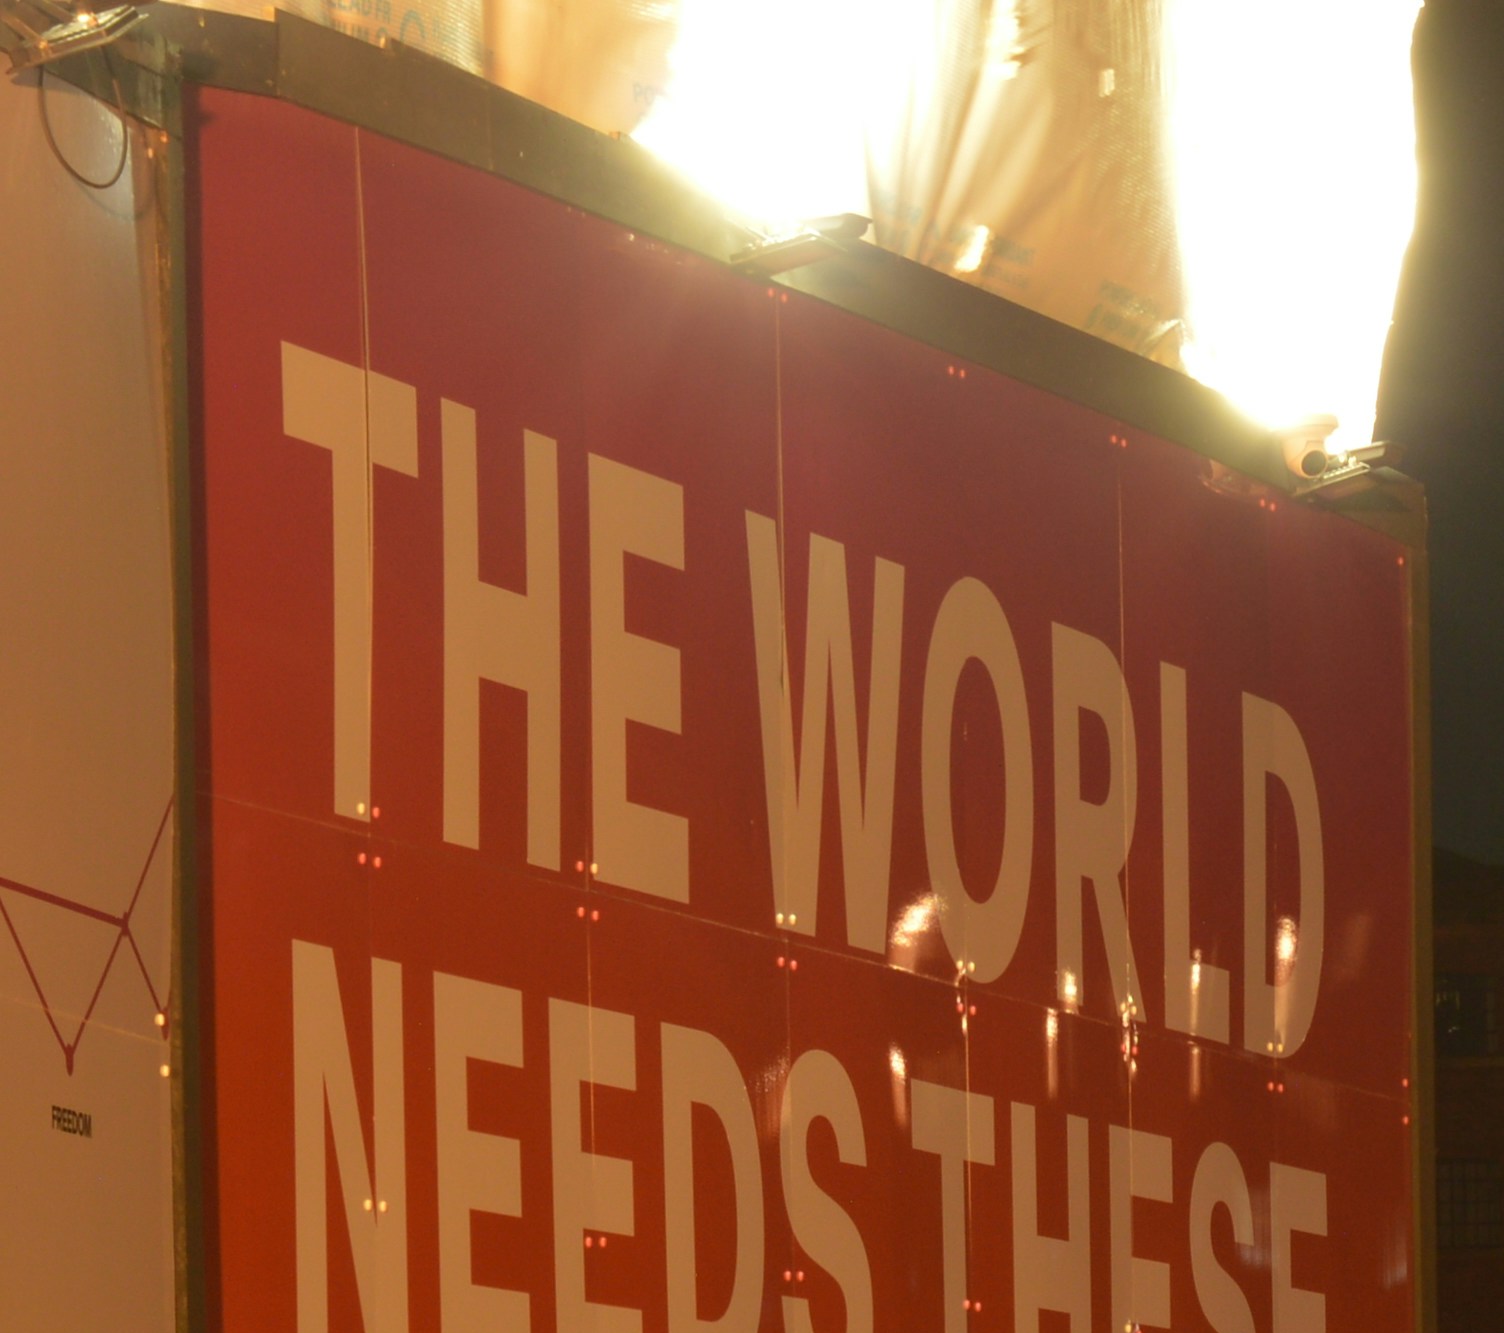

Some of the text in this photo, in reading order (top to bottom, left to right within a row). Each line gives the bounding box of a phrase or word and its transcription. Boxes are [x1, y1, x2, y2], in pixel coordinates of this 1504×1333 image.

[280, 339, 1326, 1060] THE WORLD
[51, 1105, 92, 1138] FREEDOM
